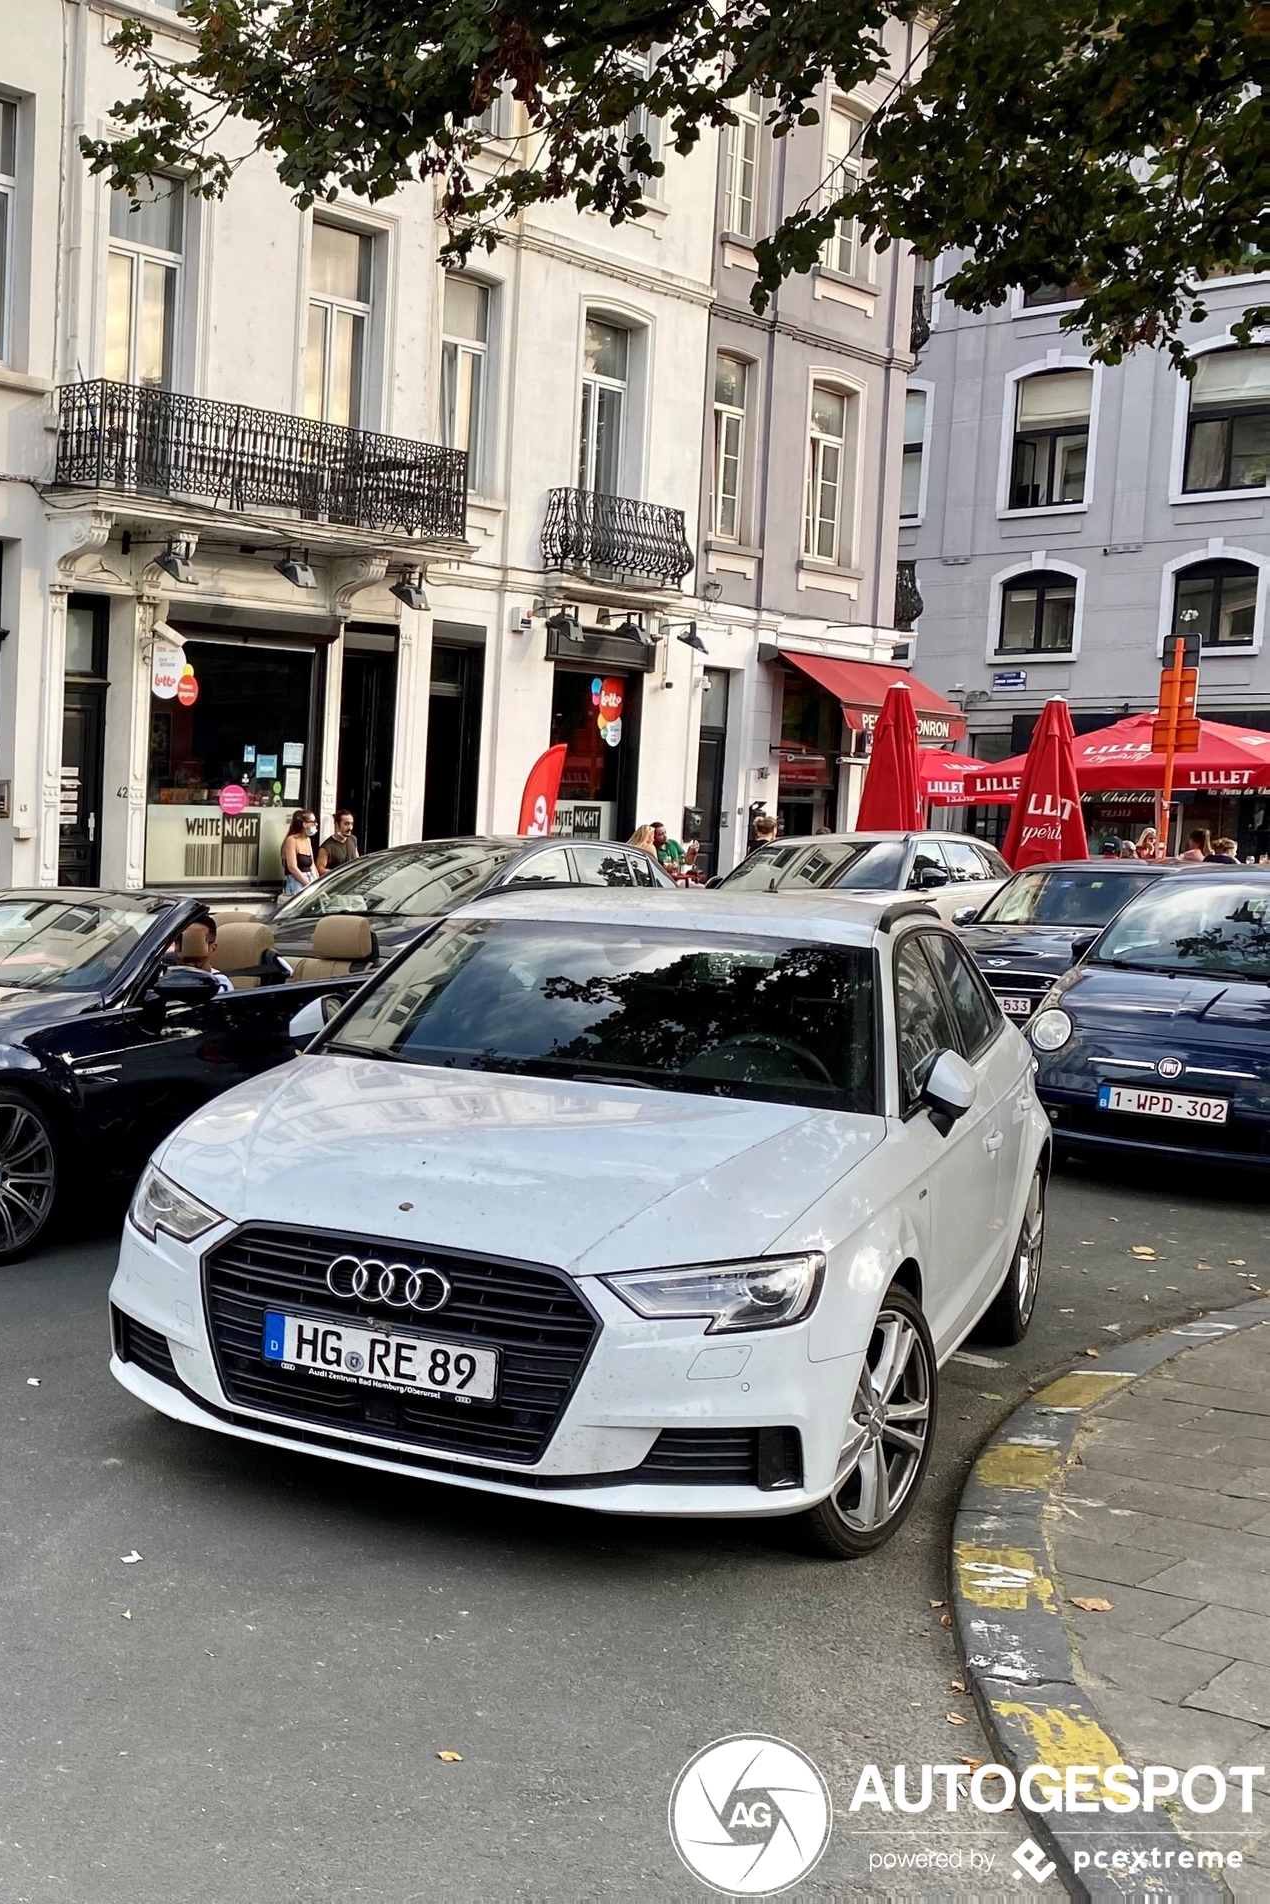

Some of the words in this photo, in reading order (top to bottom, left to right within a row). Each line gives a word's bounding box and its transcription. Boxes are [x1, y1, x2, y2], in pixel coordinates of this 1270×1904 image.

[916, 720, 950, 738] ONRON
[1083, 743, 1152, 756] LILLE
[975, 777, 1023, 792] LILLE
[1189, 770, 1256, 785] LILLET
[117, 786, 129, 799] 42
[927, 781, 965, 793] LILLET
[552, 811, 573, 827] HITE
[574, 811, 600, 828] NIGHT
[186, 818, 221, 837] WHITE
[224, 818, 258, 837] NIGHT
[1099, 1098, 1107, 1107] B
[1114, 1091, 1225, 1120] 1-WPD-302
[270, 1339, 279, 1352] D
[296, 1324, 342, 1368] HG
[368, 1338, 418, 1381] RE
[428, 1348, 476, 1390] 89
[308, 1367, 328, 1378] Audi
[328, 1371, 358, 1384] Zentrum
[358, 1377, 372, 1388] Bad
[372, 1379, 441, 1400] Homburg/Oberursel
